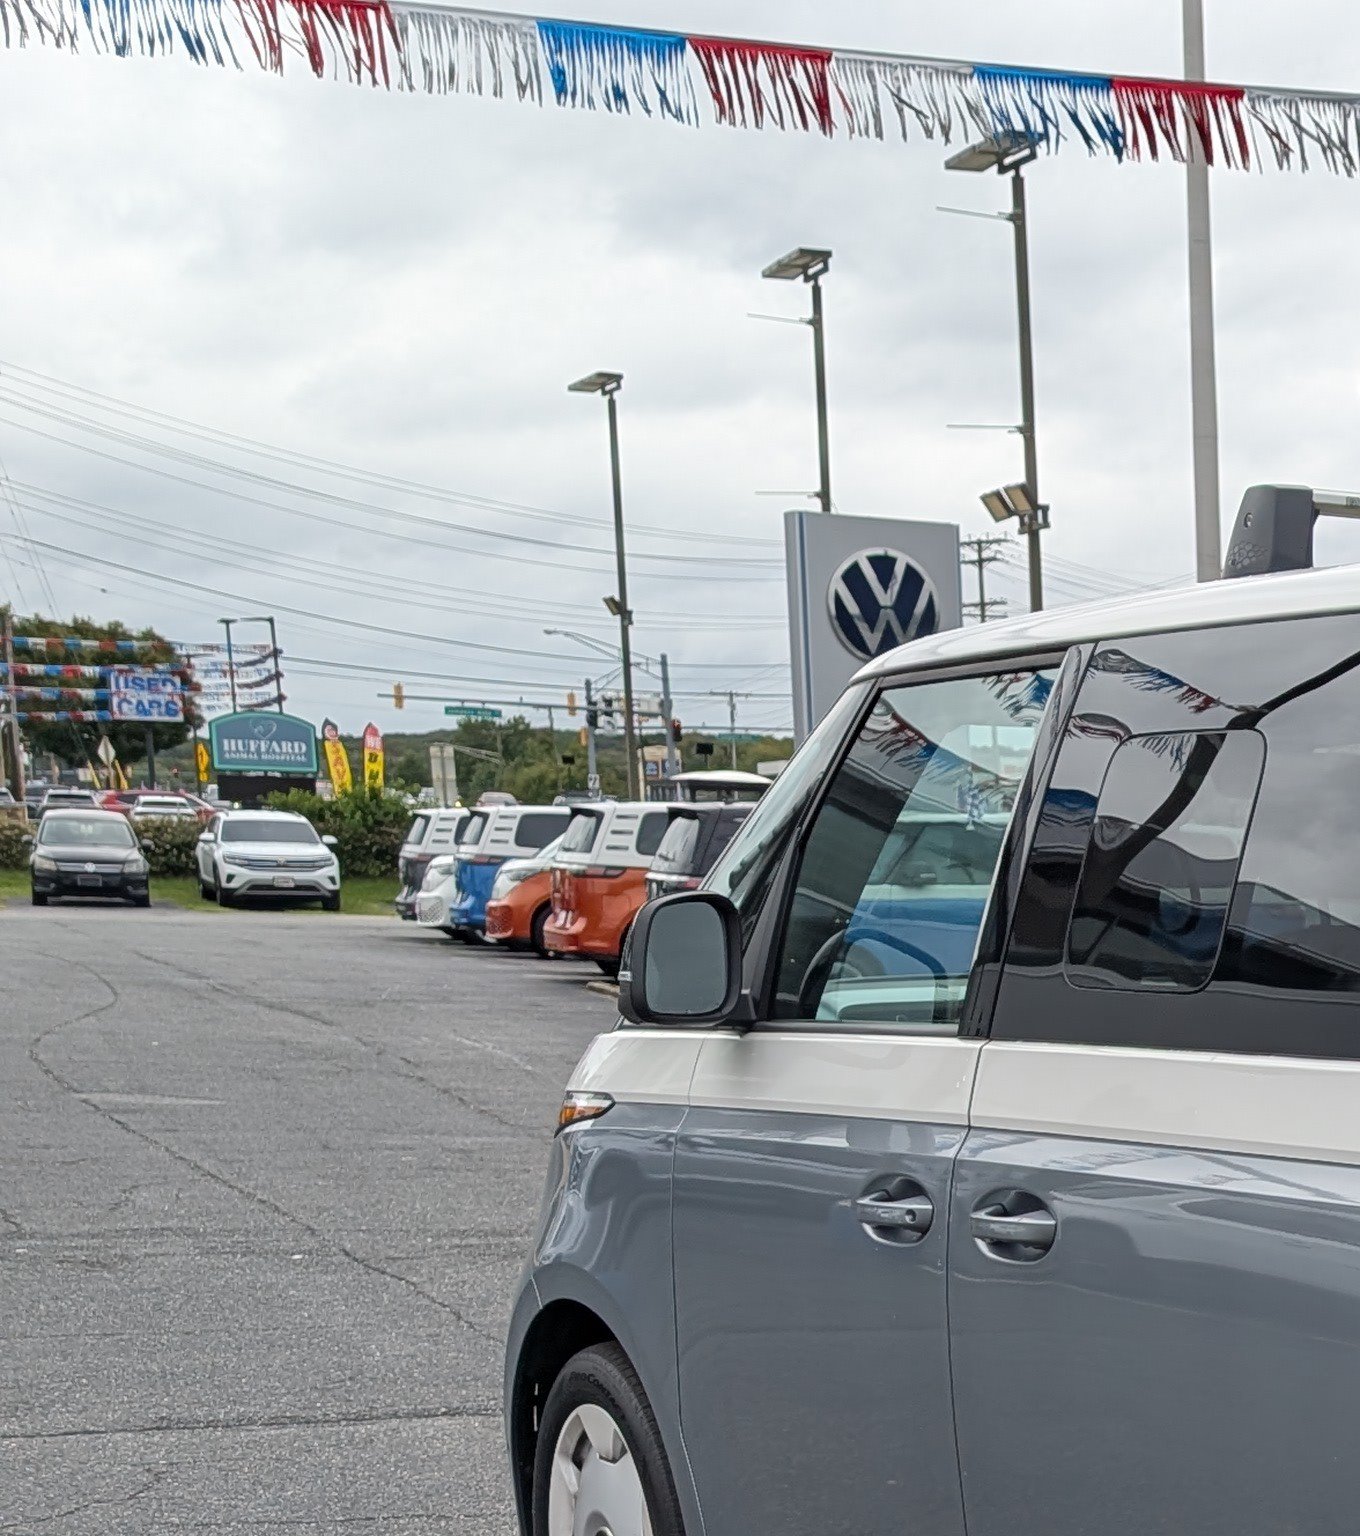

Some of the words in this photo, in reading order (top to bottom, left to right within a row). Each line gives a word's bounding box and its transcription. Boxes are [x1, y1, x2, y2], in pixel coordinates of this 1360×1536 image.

[117, 697, 179, 717] CARS
[222, 739, 307, 754] HUFFARD
[224, 752, 258, 760] ANIMAL
[261, 753, 307, 762] HOSPITAL
